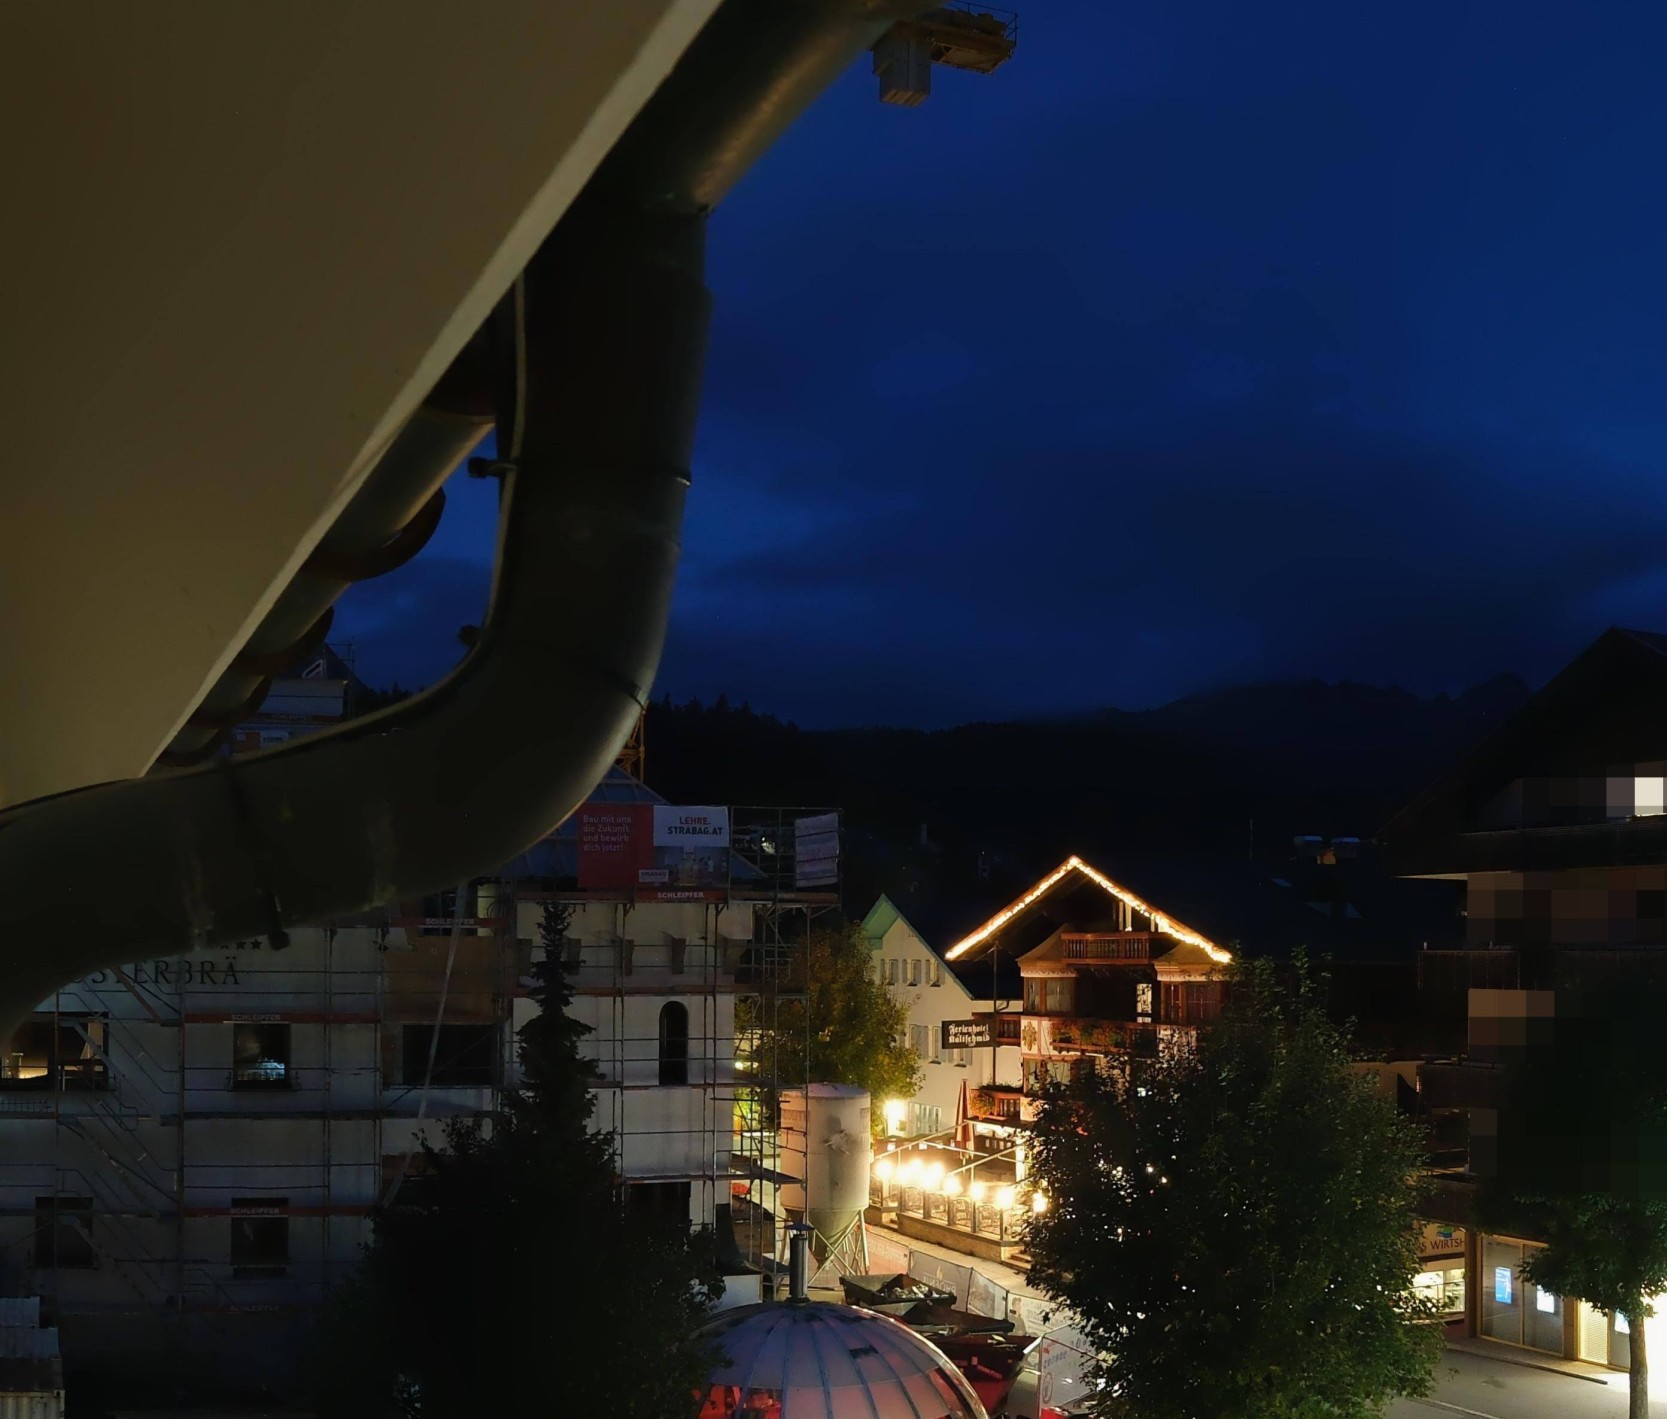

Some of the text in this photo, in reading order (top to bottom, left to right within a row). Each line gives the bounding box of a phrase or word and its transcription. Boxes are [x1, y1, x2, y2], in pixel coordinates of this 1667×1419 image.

[679, 816, 711, 825] LEHRE.
[667, 826, 723, 836] STRABAG.AT
[657, 891, 704, 899] SCHLEIPFER
